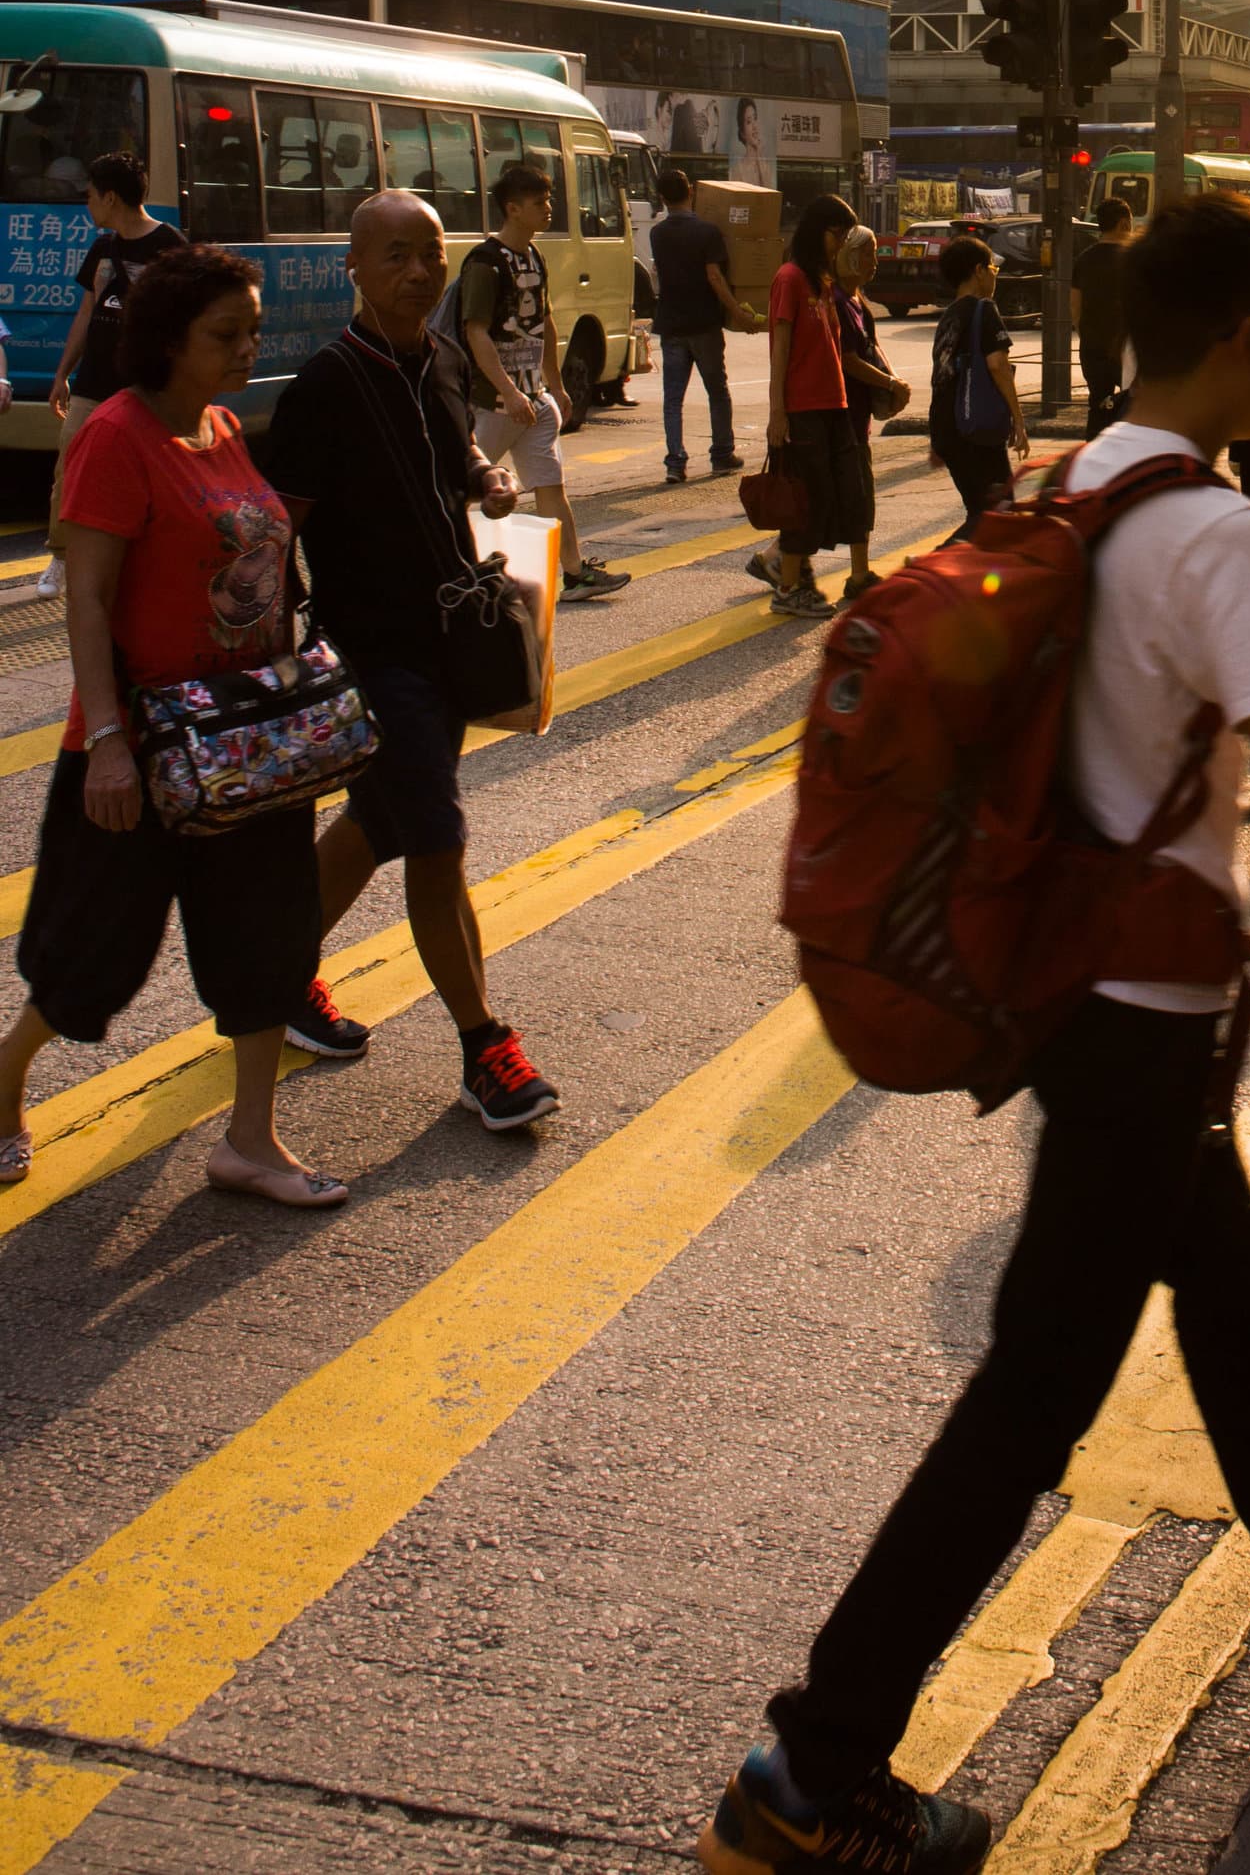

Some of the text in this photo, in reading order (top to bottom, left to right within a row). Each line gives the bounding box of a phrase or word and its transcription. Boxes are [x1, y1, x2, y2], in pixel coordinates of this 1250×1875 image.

[8, 213, 117, 243] 旺角分
[23, 284, 76, 307] 2285
